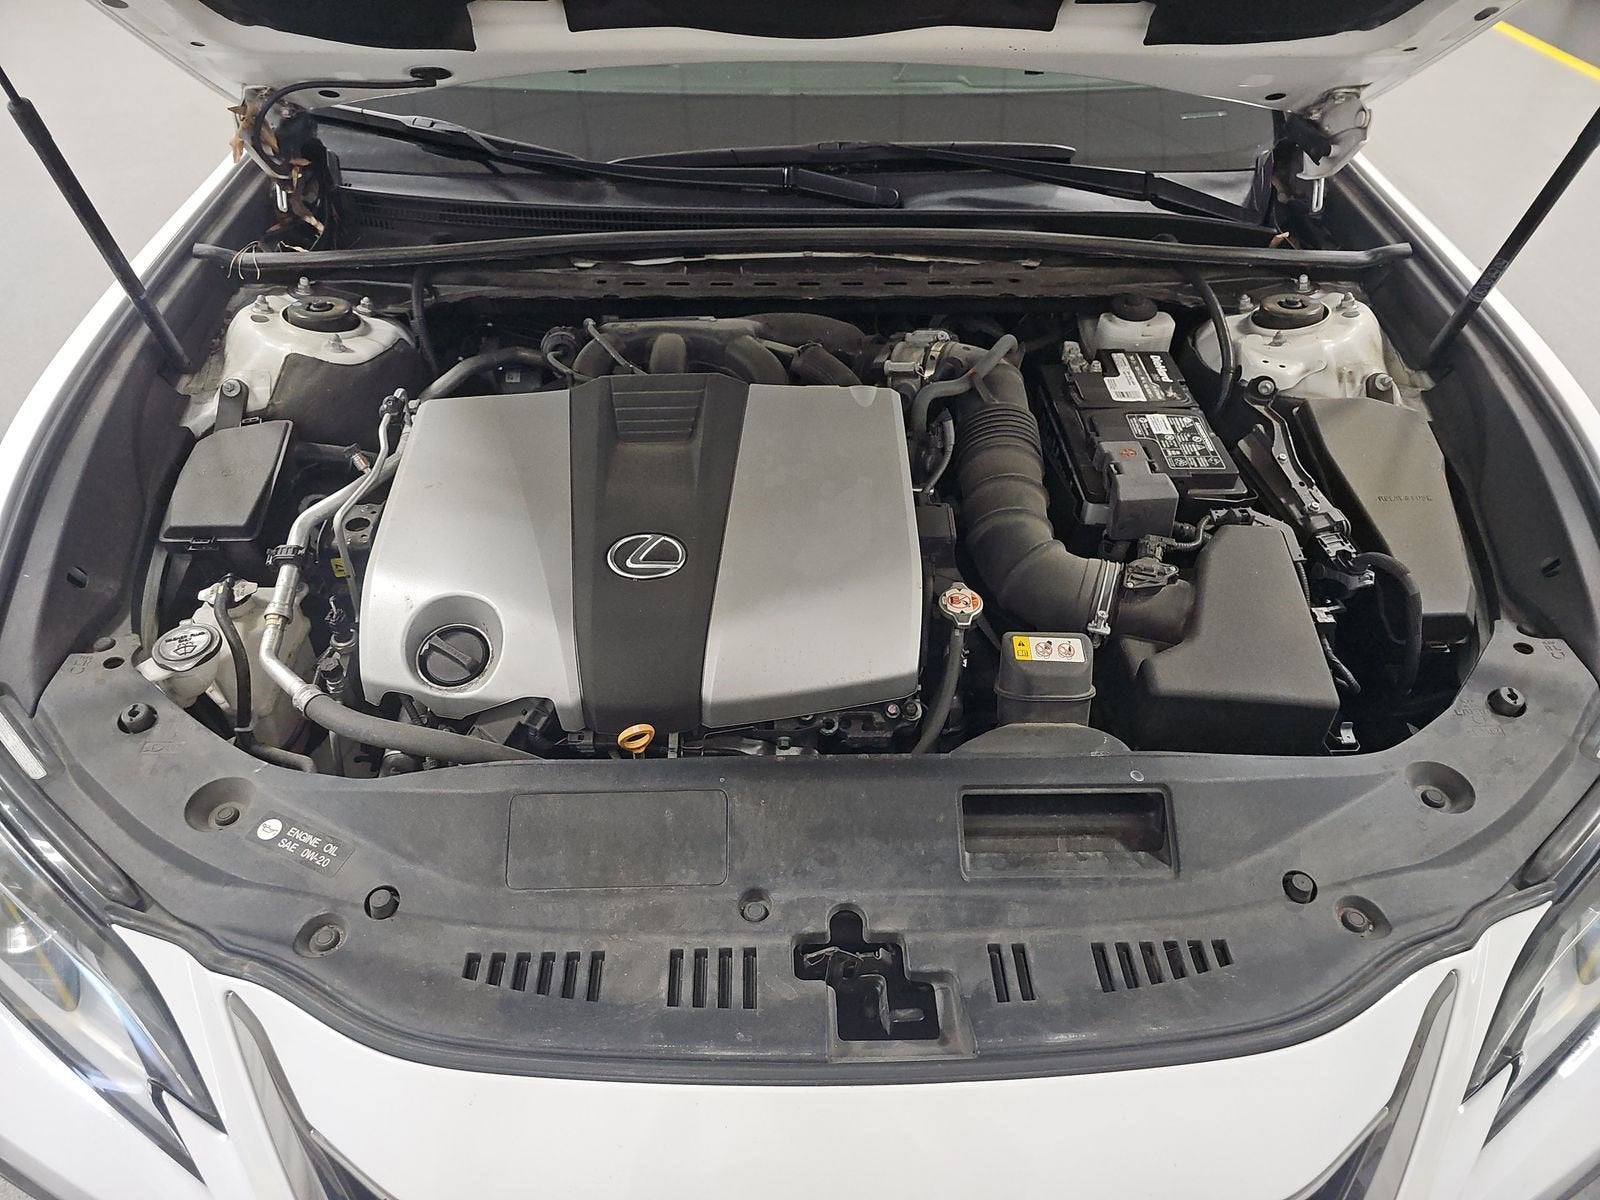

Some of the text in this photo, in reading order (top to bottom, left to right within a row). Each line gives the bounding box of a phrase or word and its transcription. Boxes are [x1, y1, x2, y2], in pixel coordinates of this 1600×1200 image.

[1149, 355, 1174, 383] DieHard
[277, 838, 331, 868] SAE 0W-20
[286, 827, 338, 856] ENGINE OIL
